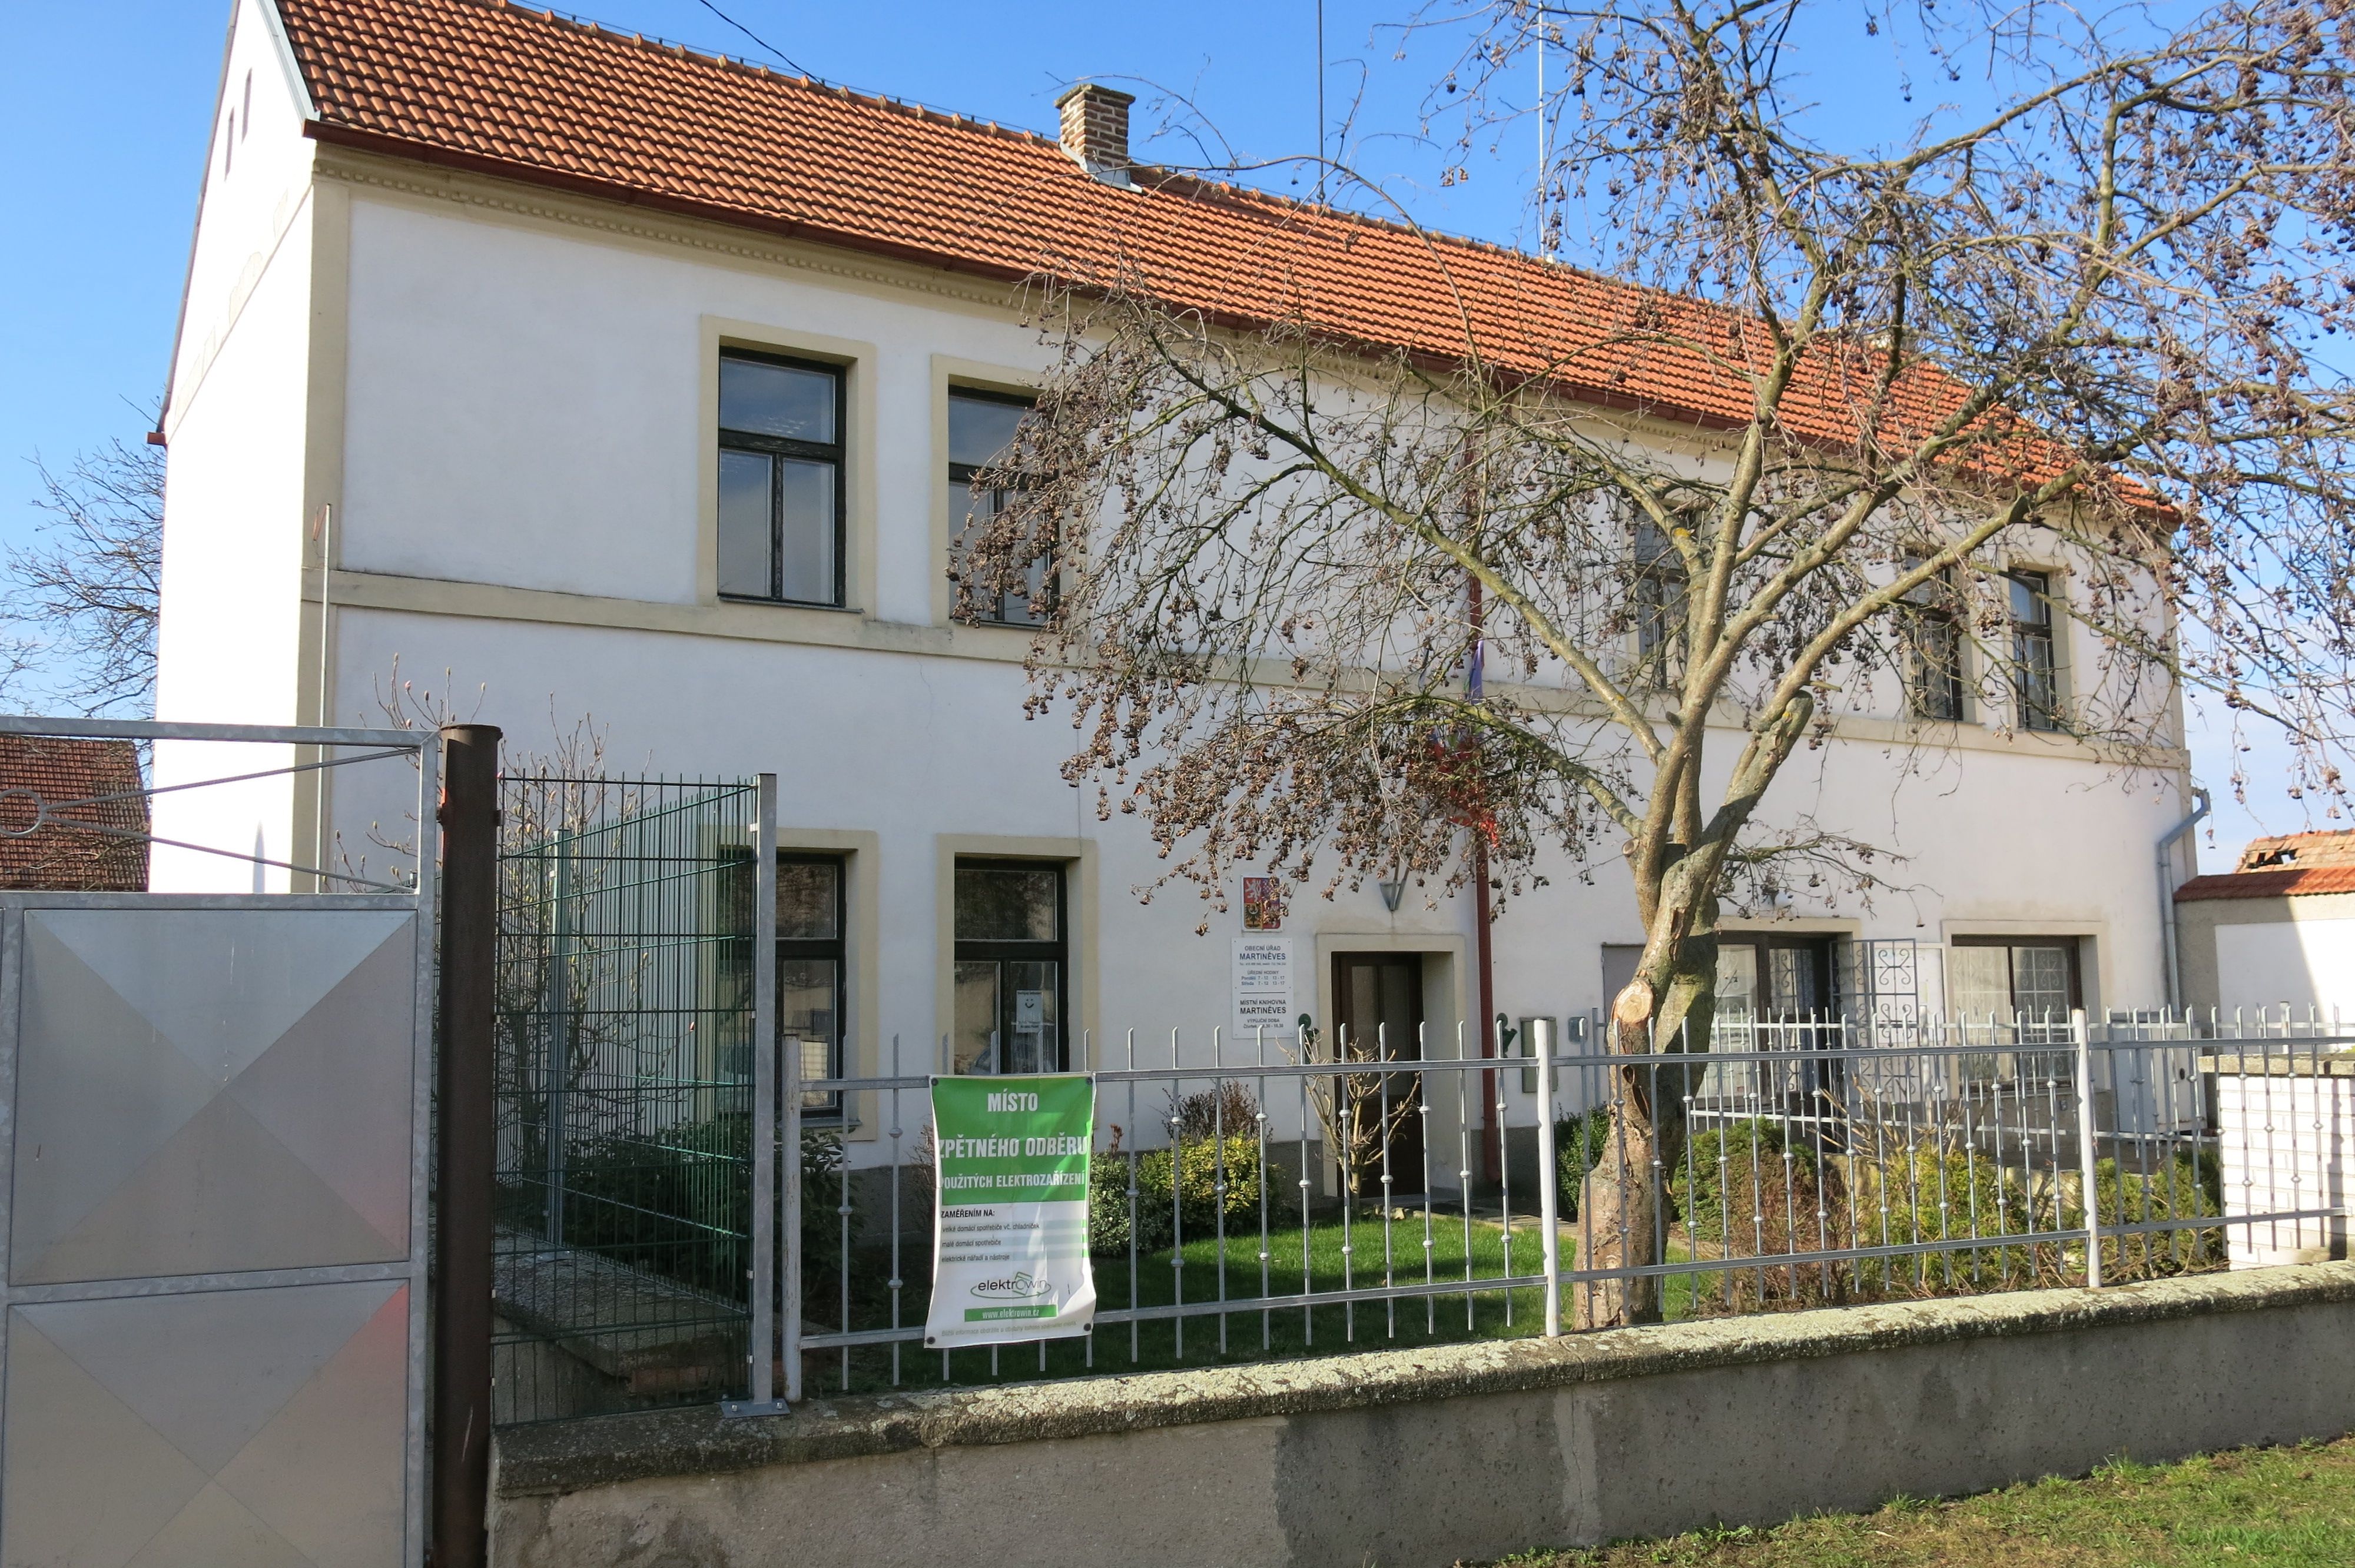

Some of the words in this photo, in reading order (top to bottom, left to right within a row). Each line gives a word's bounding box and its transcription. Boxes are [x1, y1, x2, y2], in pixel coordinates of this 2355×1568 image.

[1239, 952, 1286, 960] MARTINĚVES
[1240, 1005, 1286, 1014] MARTINĚVES
[988, 1088, 1038, 1112] MÍSTO
[1026, 1132, 1087, 1156] ODBĚRU
[996, 1170, 1085, 1187] ELEKTROZAŘÍZENÍ
[941, 1208, 981, 1218] ZAMĚŘENÍM
[978, 1278, 1047, 1291] elektrowin
[982, 1308, 1040, 1318] www.elektrowin.cz
